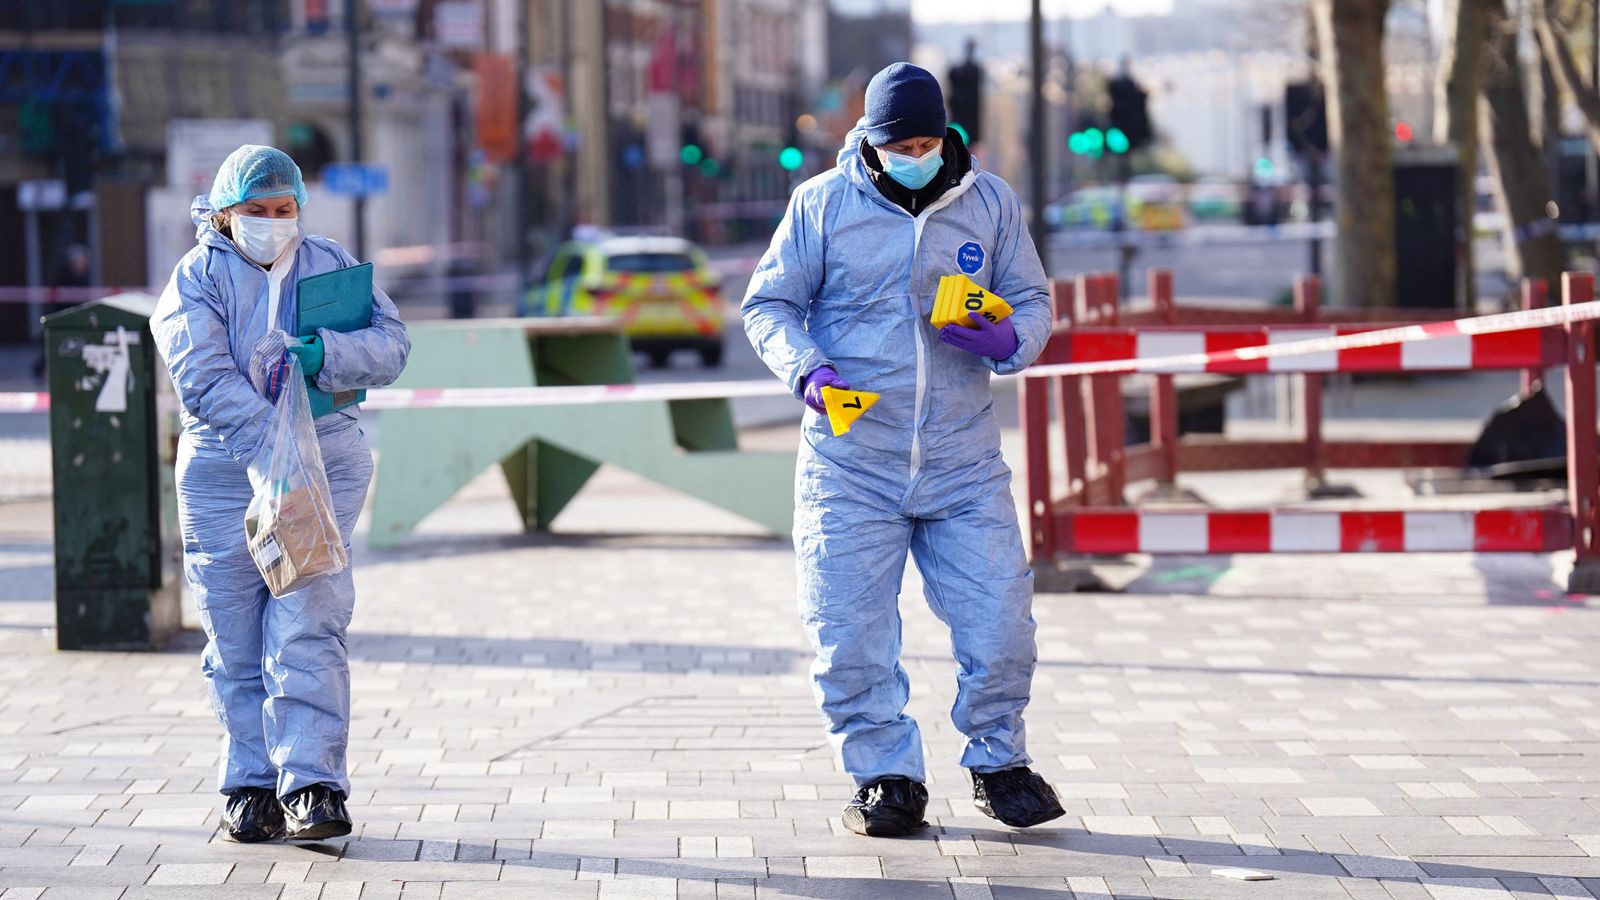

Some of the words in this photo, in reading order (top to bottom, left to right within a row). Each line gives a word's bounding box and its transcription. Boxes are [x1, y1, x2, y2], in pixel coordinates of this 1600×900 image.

[962, 252, 979, 263] Tyvek
[965, 290, 985, 311] 10
[842, 396, 862, 409] 7
